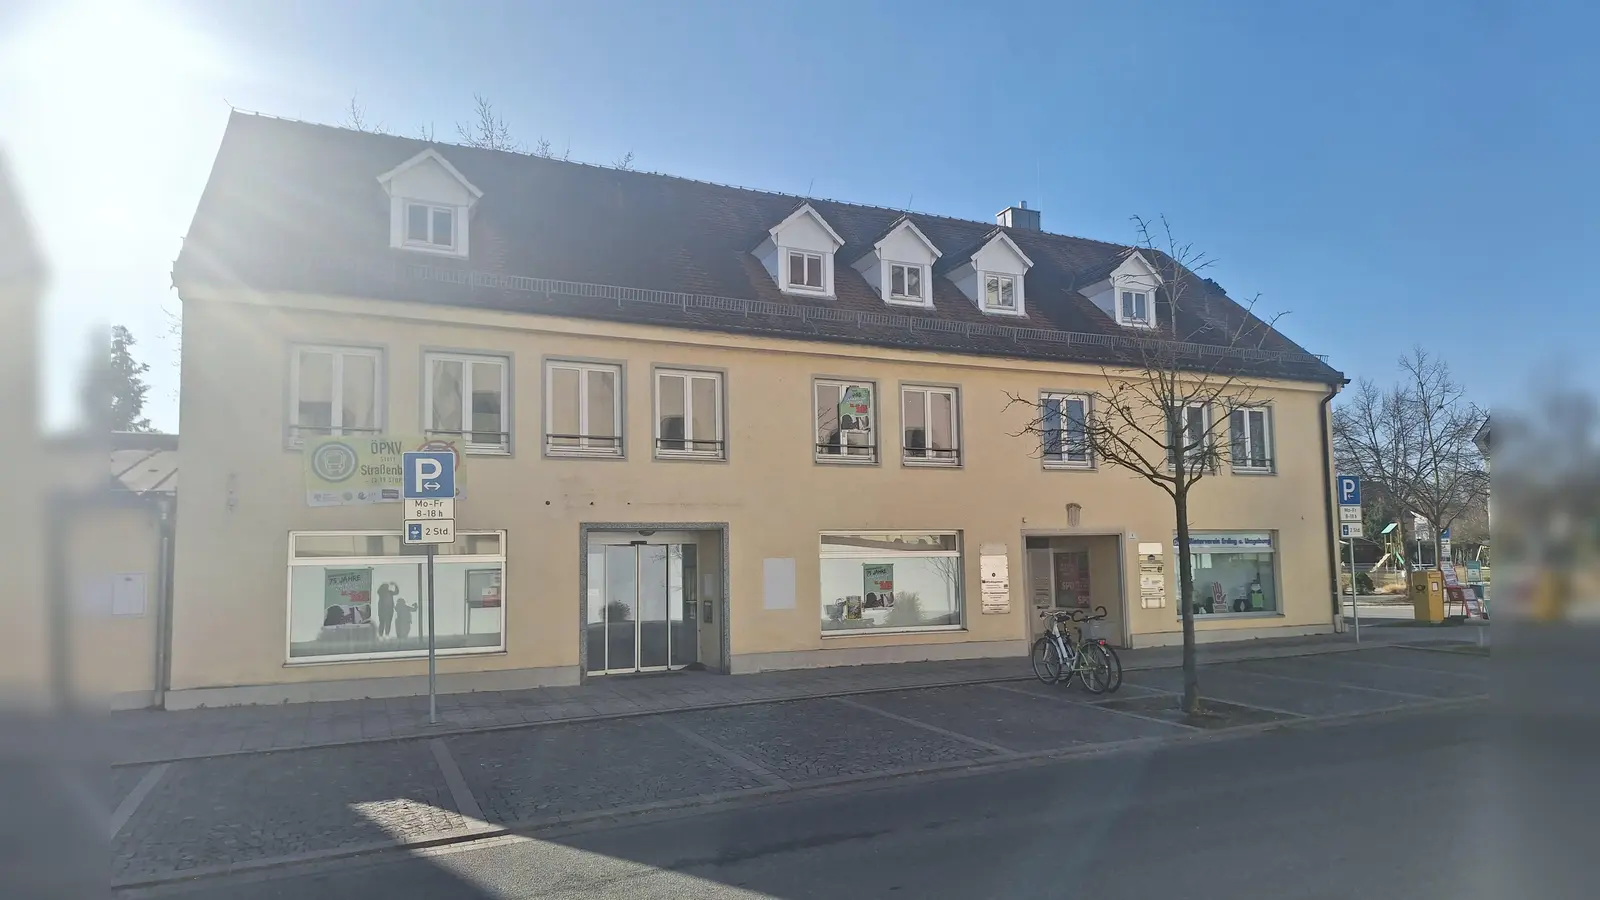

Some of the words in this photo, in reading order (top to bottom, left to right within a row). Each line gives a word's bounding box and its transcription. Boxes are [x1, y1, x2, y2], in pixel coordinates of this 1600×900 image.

[371, 440, 402, 455] ÖPNV
[360, 464, 403, 475] Straßenb
[415, 458, 443, 493] P
[415, 500, 444, 508] Mo-Fr
[416, 509, 437, 518] 8-18
[438, 509, 443, 518] h
[425, 527, 431, 536] 2
